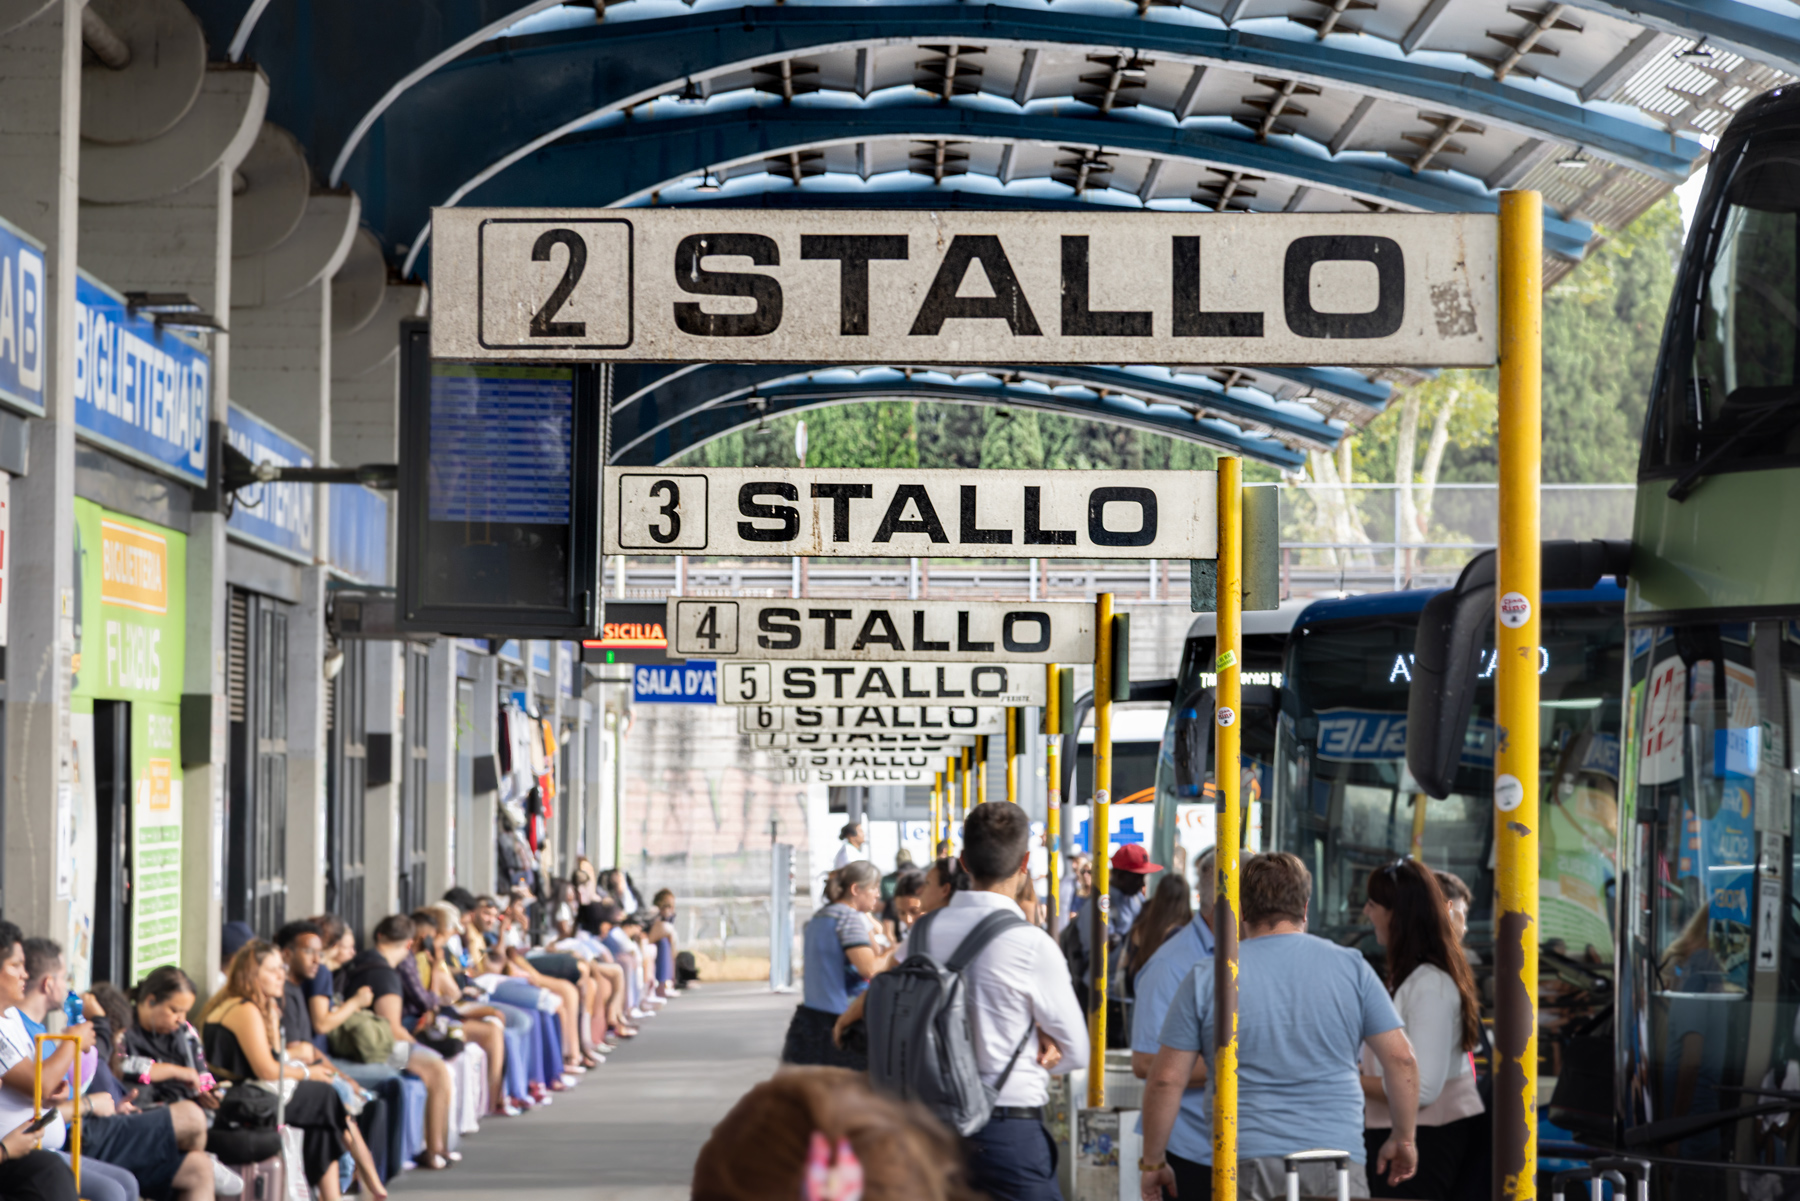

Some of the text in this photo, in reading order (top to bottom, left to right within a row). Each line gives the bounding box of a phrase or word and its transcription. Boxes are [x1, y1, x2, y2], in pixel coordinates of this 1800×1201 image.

[530, 228, 1405, 339] 2 STALLO
[649, 481, 1158, 544] 3 STALLO
[103, 539, 162, 592] BIGLIETTERIA
[603, 623, 665, 639] SICILIA
[696, 606, 1051, 652] 4 STALLO
[636, 668, 716, 696] SALA D'A
[741, 666, 1008, 700] 5 STALLO
[758, 706, 978, 729] 6 STALLO
